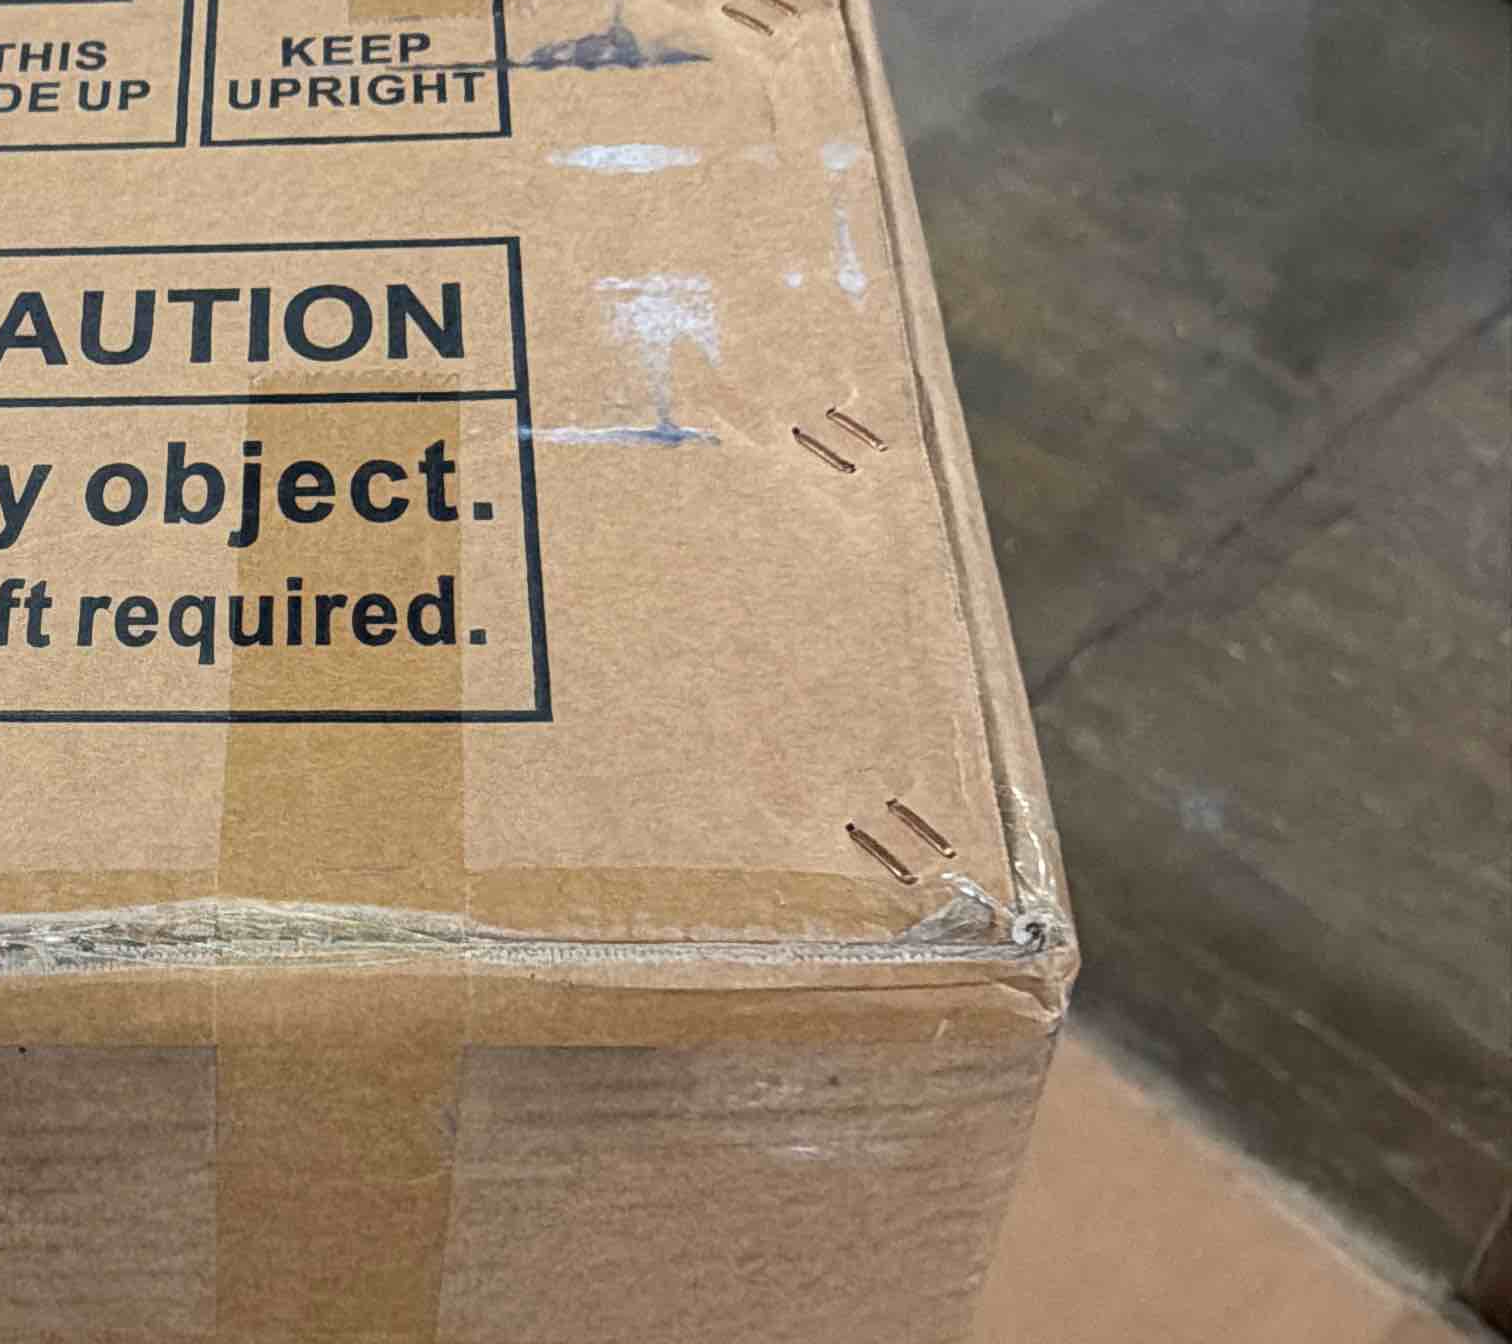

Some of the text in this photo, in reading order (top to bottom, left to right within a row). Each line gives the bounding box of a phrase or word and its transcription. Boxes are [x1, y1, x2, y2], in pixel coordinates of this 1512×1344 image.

[280, 32, 432, 68] KEEP
[77, 79, 151, 113] UP
[227, 71, 486, 112] UPRIGHT
[84, 439, 497, 549] object.
[75, 576, 488, 666] required.
